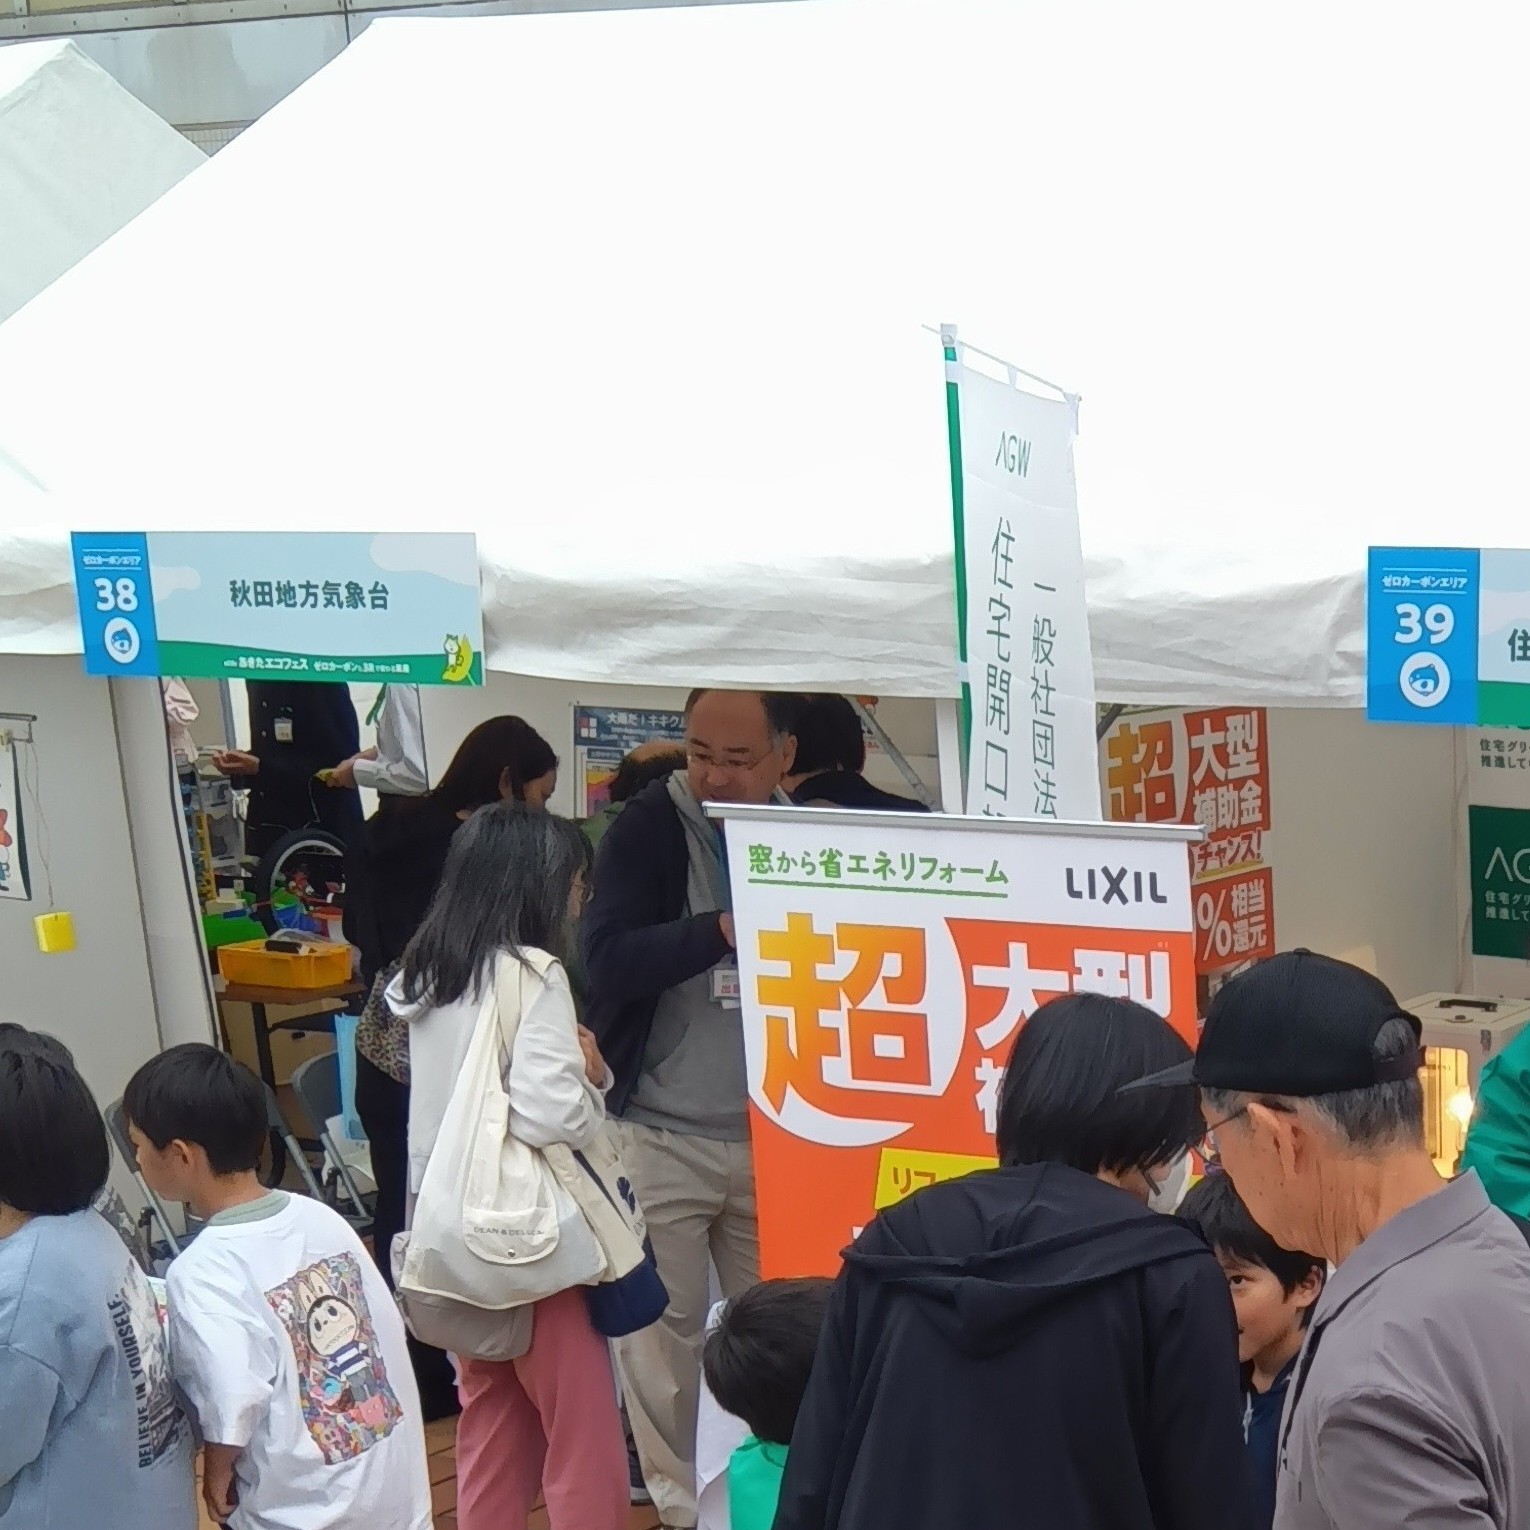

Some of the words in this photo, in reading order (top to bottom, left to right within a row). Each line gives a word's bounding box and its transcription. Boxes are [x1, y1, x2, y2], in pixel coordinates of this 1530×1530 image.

[995, 431, 1032, 478] AGW
[95, 577, 138, 612] 38
[229, 579, 389, 610] 秋田地方気象台
[1394, 603, 1454, 644] 39
[983, 516, 1016, 817] 住宅開口
[1190, 710, 1261, 786] 大型
[1107, 722, 1177, 823] 超
[1193, 779, 1263, 836] 補助金
[747, 842, 1010, 886] 窓から省エネリフォーム
[1065, 865, 1168, 906] LIXIL
[1231, 878, 1266, 919] 相当
[755, 911, 936, 1131] 超
